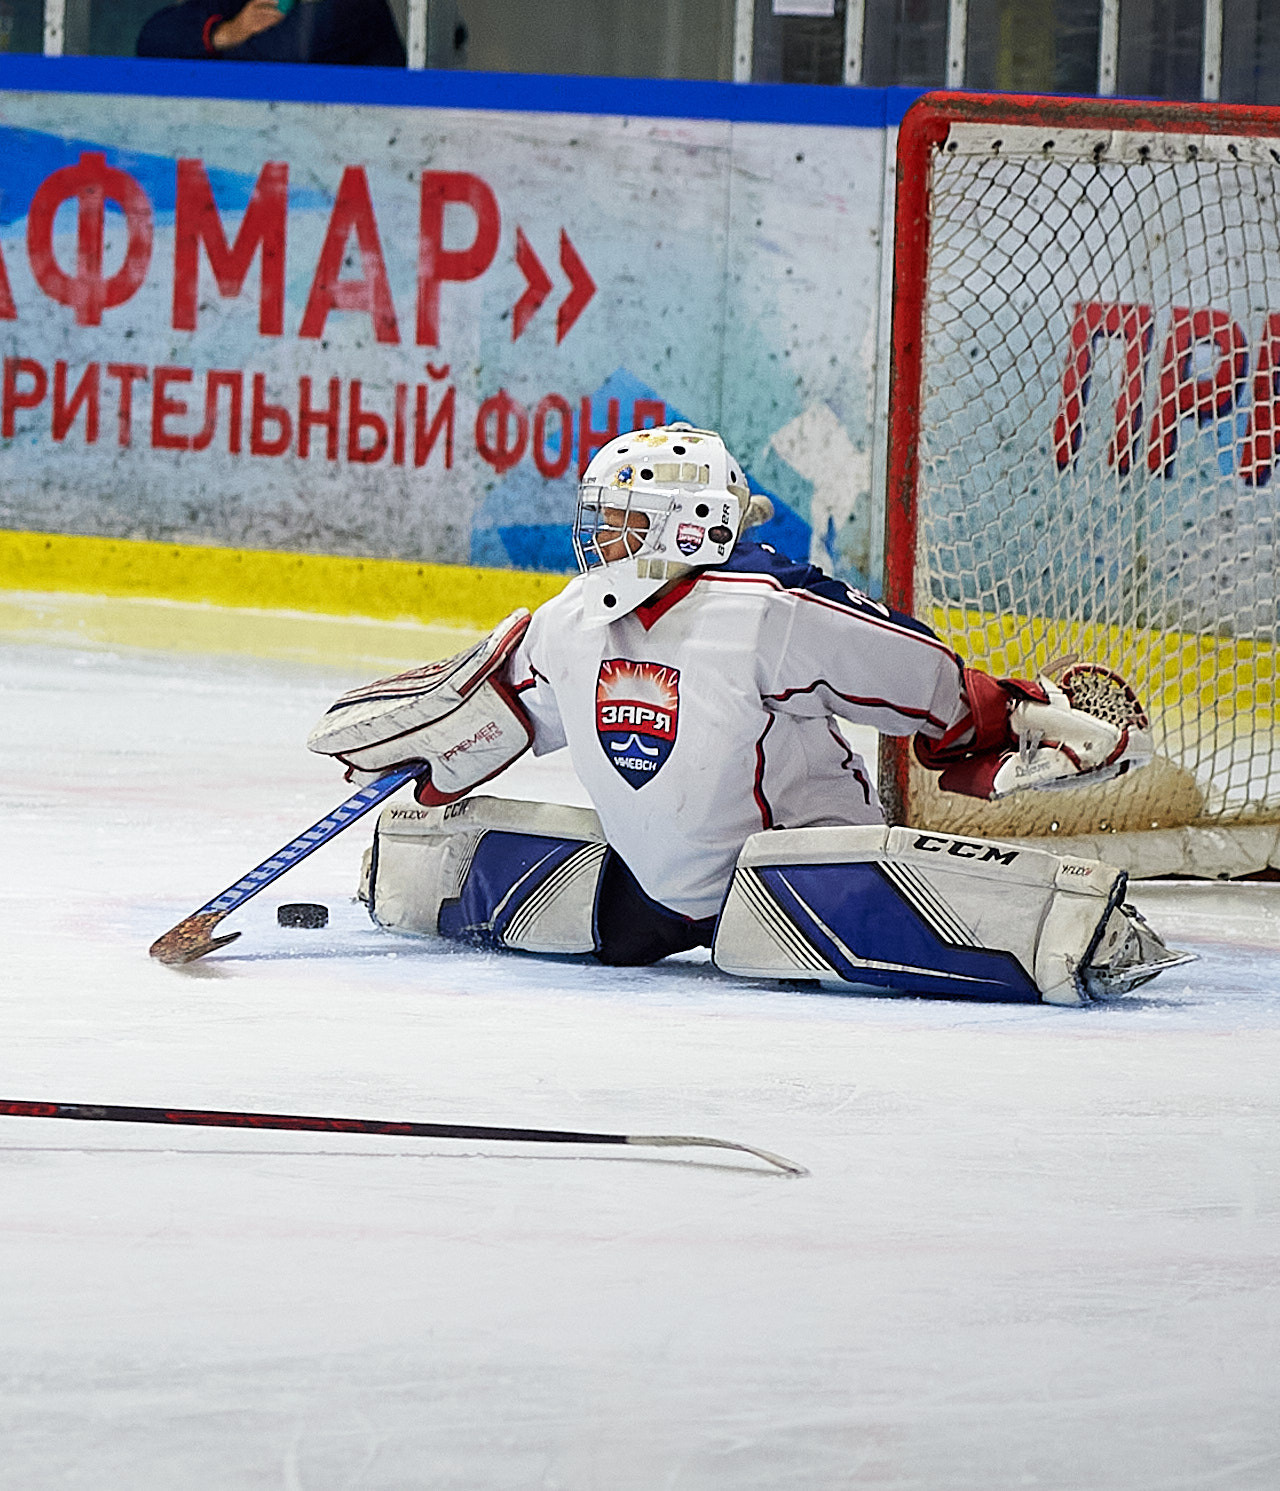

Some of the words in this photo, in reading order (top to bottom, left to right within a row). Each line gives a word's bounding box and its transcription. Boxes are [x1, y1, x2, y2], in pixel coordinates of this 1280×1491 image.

[601, 705, 671, 733] ЗАРЯ
[443, 721, 499, 761] PREMIER
[913, 834, 1020, 866] CCM
